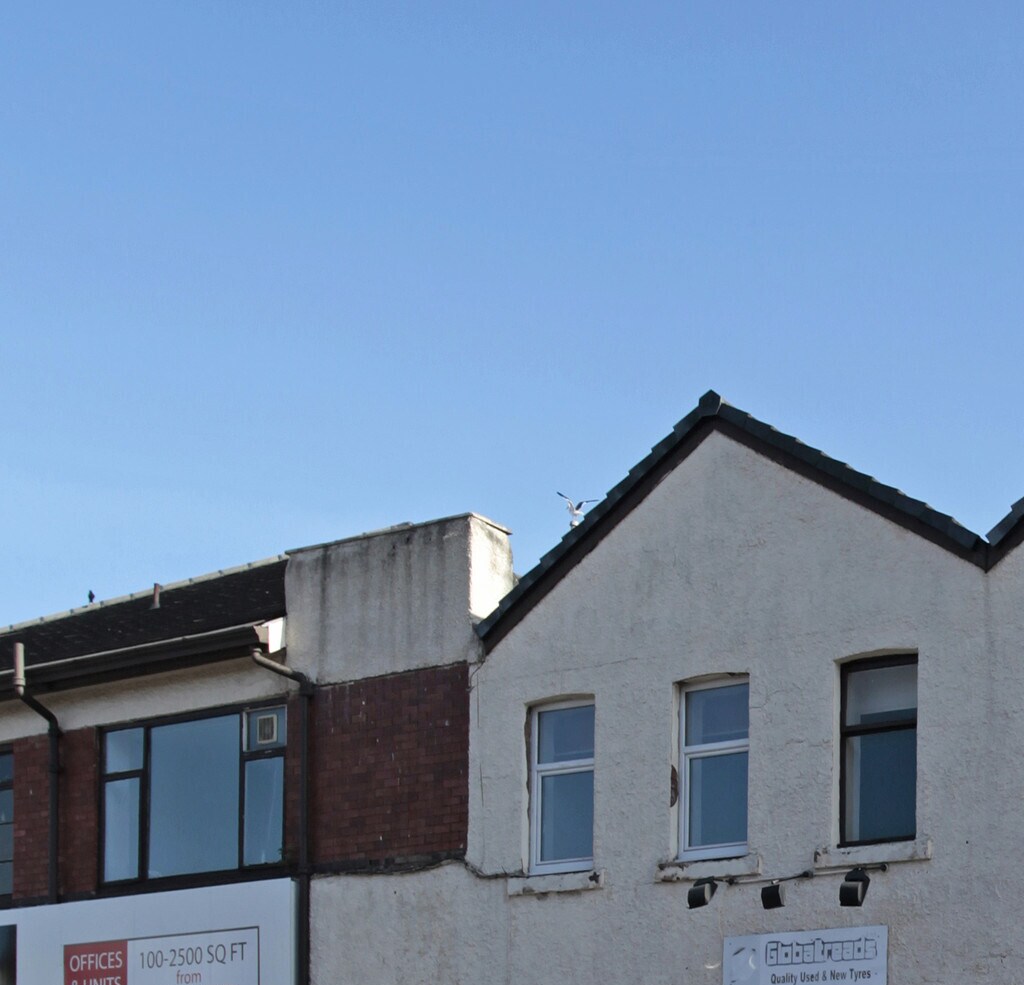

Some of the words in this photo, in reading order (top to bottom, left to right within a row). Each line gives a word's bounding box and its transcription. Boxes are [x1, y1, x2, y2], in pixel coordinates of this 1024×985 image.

[69, 951, 123, 972] OFFICES
[139, 946, 203, 969] 100-2500
[206, 944, 227, 965] SQ
[230, 942, 247, 961] FT
[176, 970, 202, 984] from
[771, 973, 798, 985] Quality
[800, 971, 819, 983] Used
[822, 971, 827, 982] &
[830, 969, 847, 980] New
[849, 967, 871, 981] Tyres
